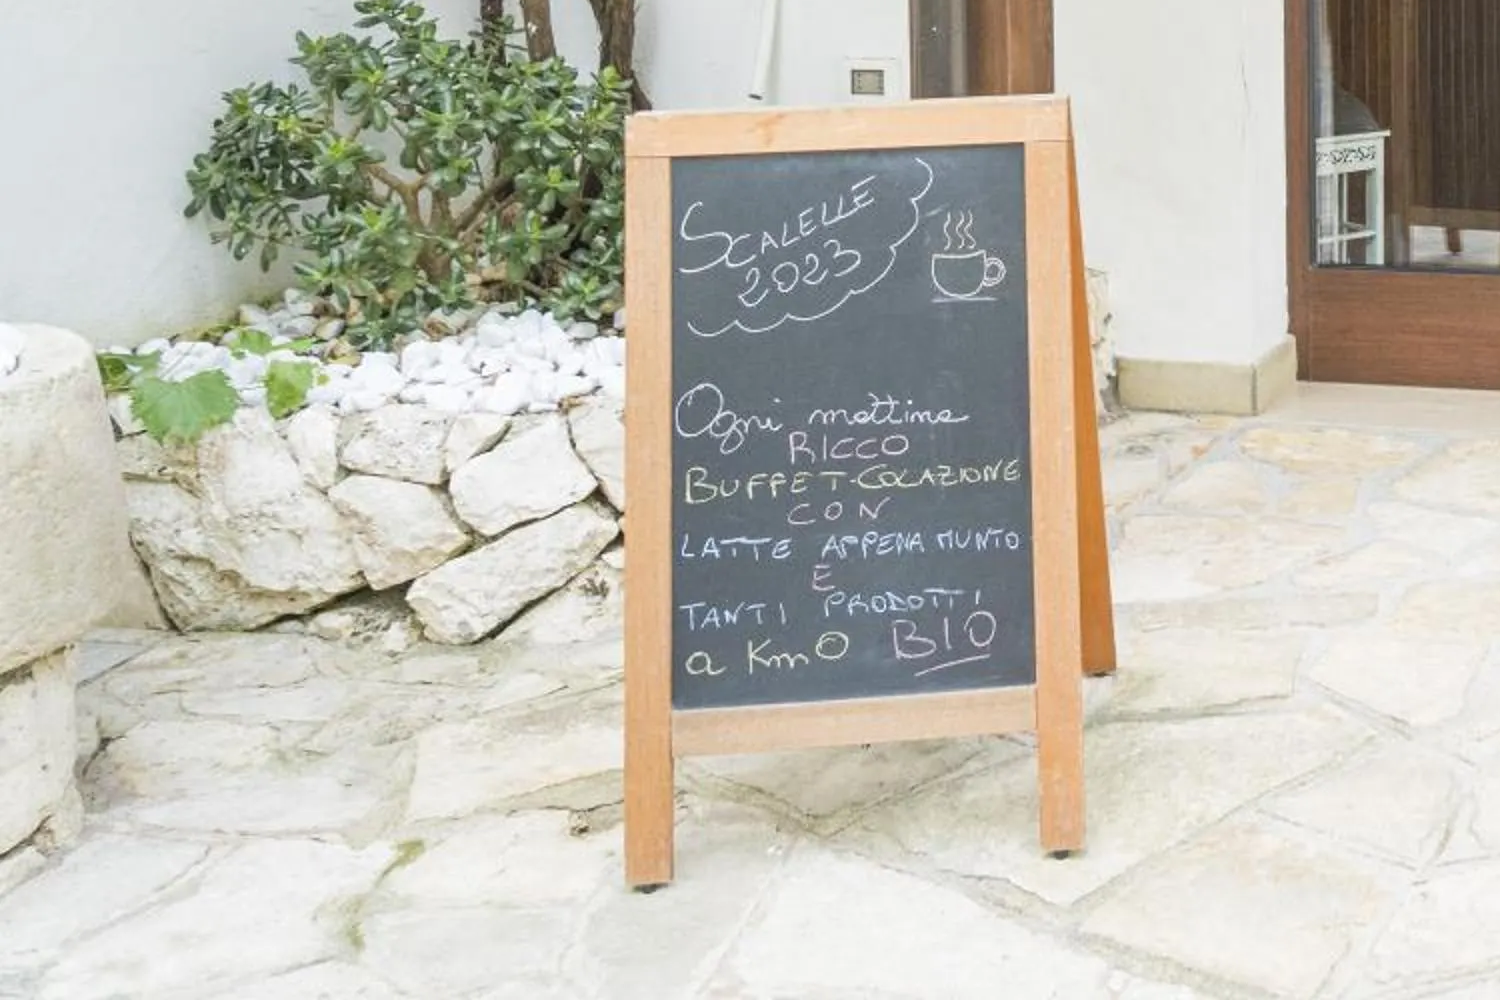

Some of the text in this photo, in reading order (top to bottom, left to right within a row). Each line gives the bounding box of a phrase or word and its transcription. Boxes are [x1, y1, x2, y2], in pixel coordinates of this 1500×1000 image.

[737, 238, 861, 308] 2023
[675, 383, 783, 455] Ogni
[789, 431, 910, 464] RICCO
[787, 497, 891, 525] CON
[679, 527, 1020, 561] LATTE APPENA MUNTO
[811, 565, 836, 591] E
[679, 588, 982, 631] TANTI PRODOTTI
[685, 651, 726, 676] a
[892, 611, 998, 660] BIO
